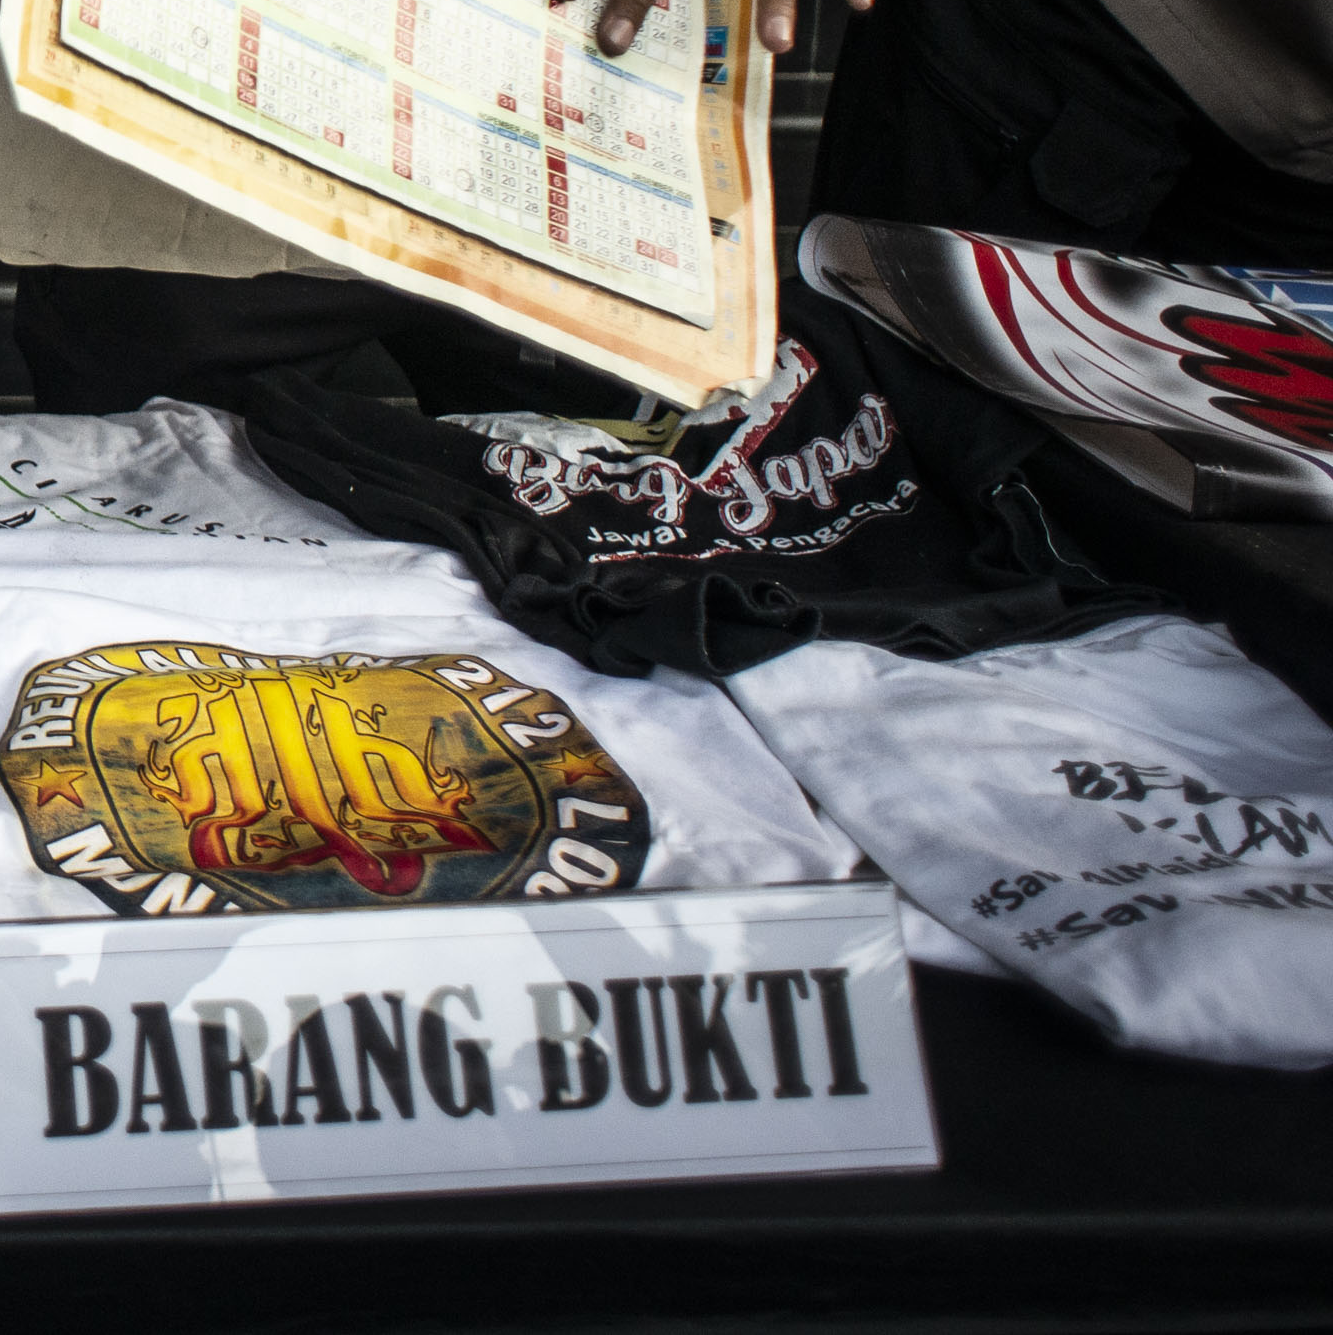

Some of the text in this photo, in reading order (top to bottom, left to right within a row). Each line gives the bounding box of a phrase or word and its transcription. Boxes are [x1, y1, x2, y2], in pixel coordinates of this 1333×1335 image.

[551, 192, 566, 206] 13
[551, 209, 567, 224] 20
[551, 226, 567, 242] 27
[749, 478, 920, 552] Pengacara
[444, 657, 575, 750] 212
[33, 965, 870, 1139] BARANG BUKTI
